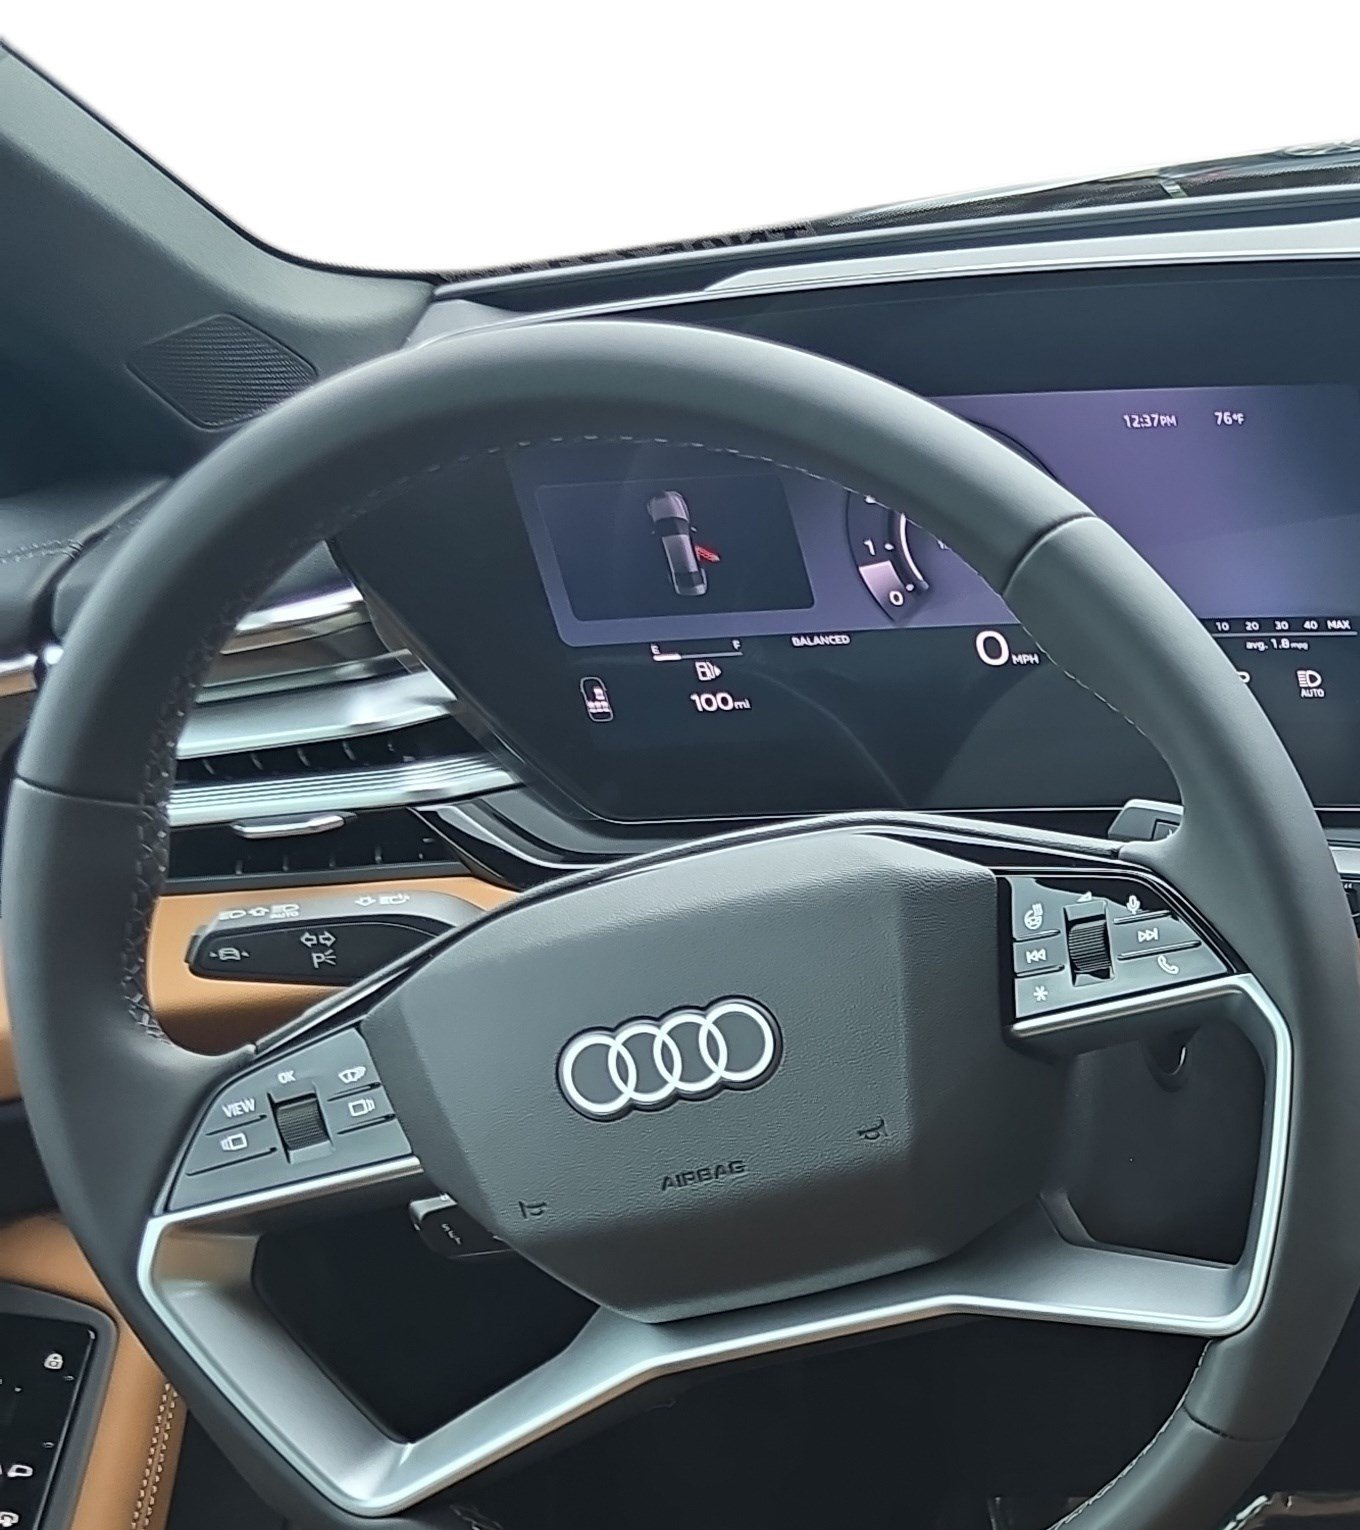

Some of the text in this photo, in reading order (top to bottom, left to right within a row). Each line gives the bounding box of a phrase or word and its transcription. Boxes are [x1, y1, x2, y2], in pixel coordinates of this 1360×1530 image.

[863, 538, 876, 556] 1
[888, 590, 904, 606] 0
[1215, 620, 1351, 632] 10 20 30 40 MAX
[732, 640, 742, 651] F
[792, 634, 851, 648] BALANCED
[975, 630, 1040, 666] 0 MPH
[1246, 640, 1269, 652] avg.
[650, 644, 660, 655] E
[1300, 688, 1324, 698] AUTO
[278, 1070, 296, 1084] OK
[222, 1098, 256, 1118] VIEW
[660, 1160, 746, 1191] AIRBAG
